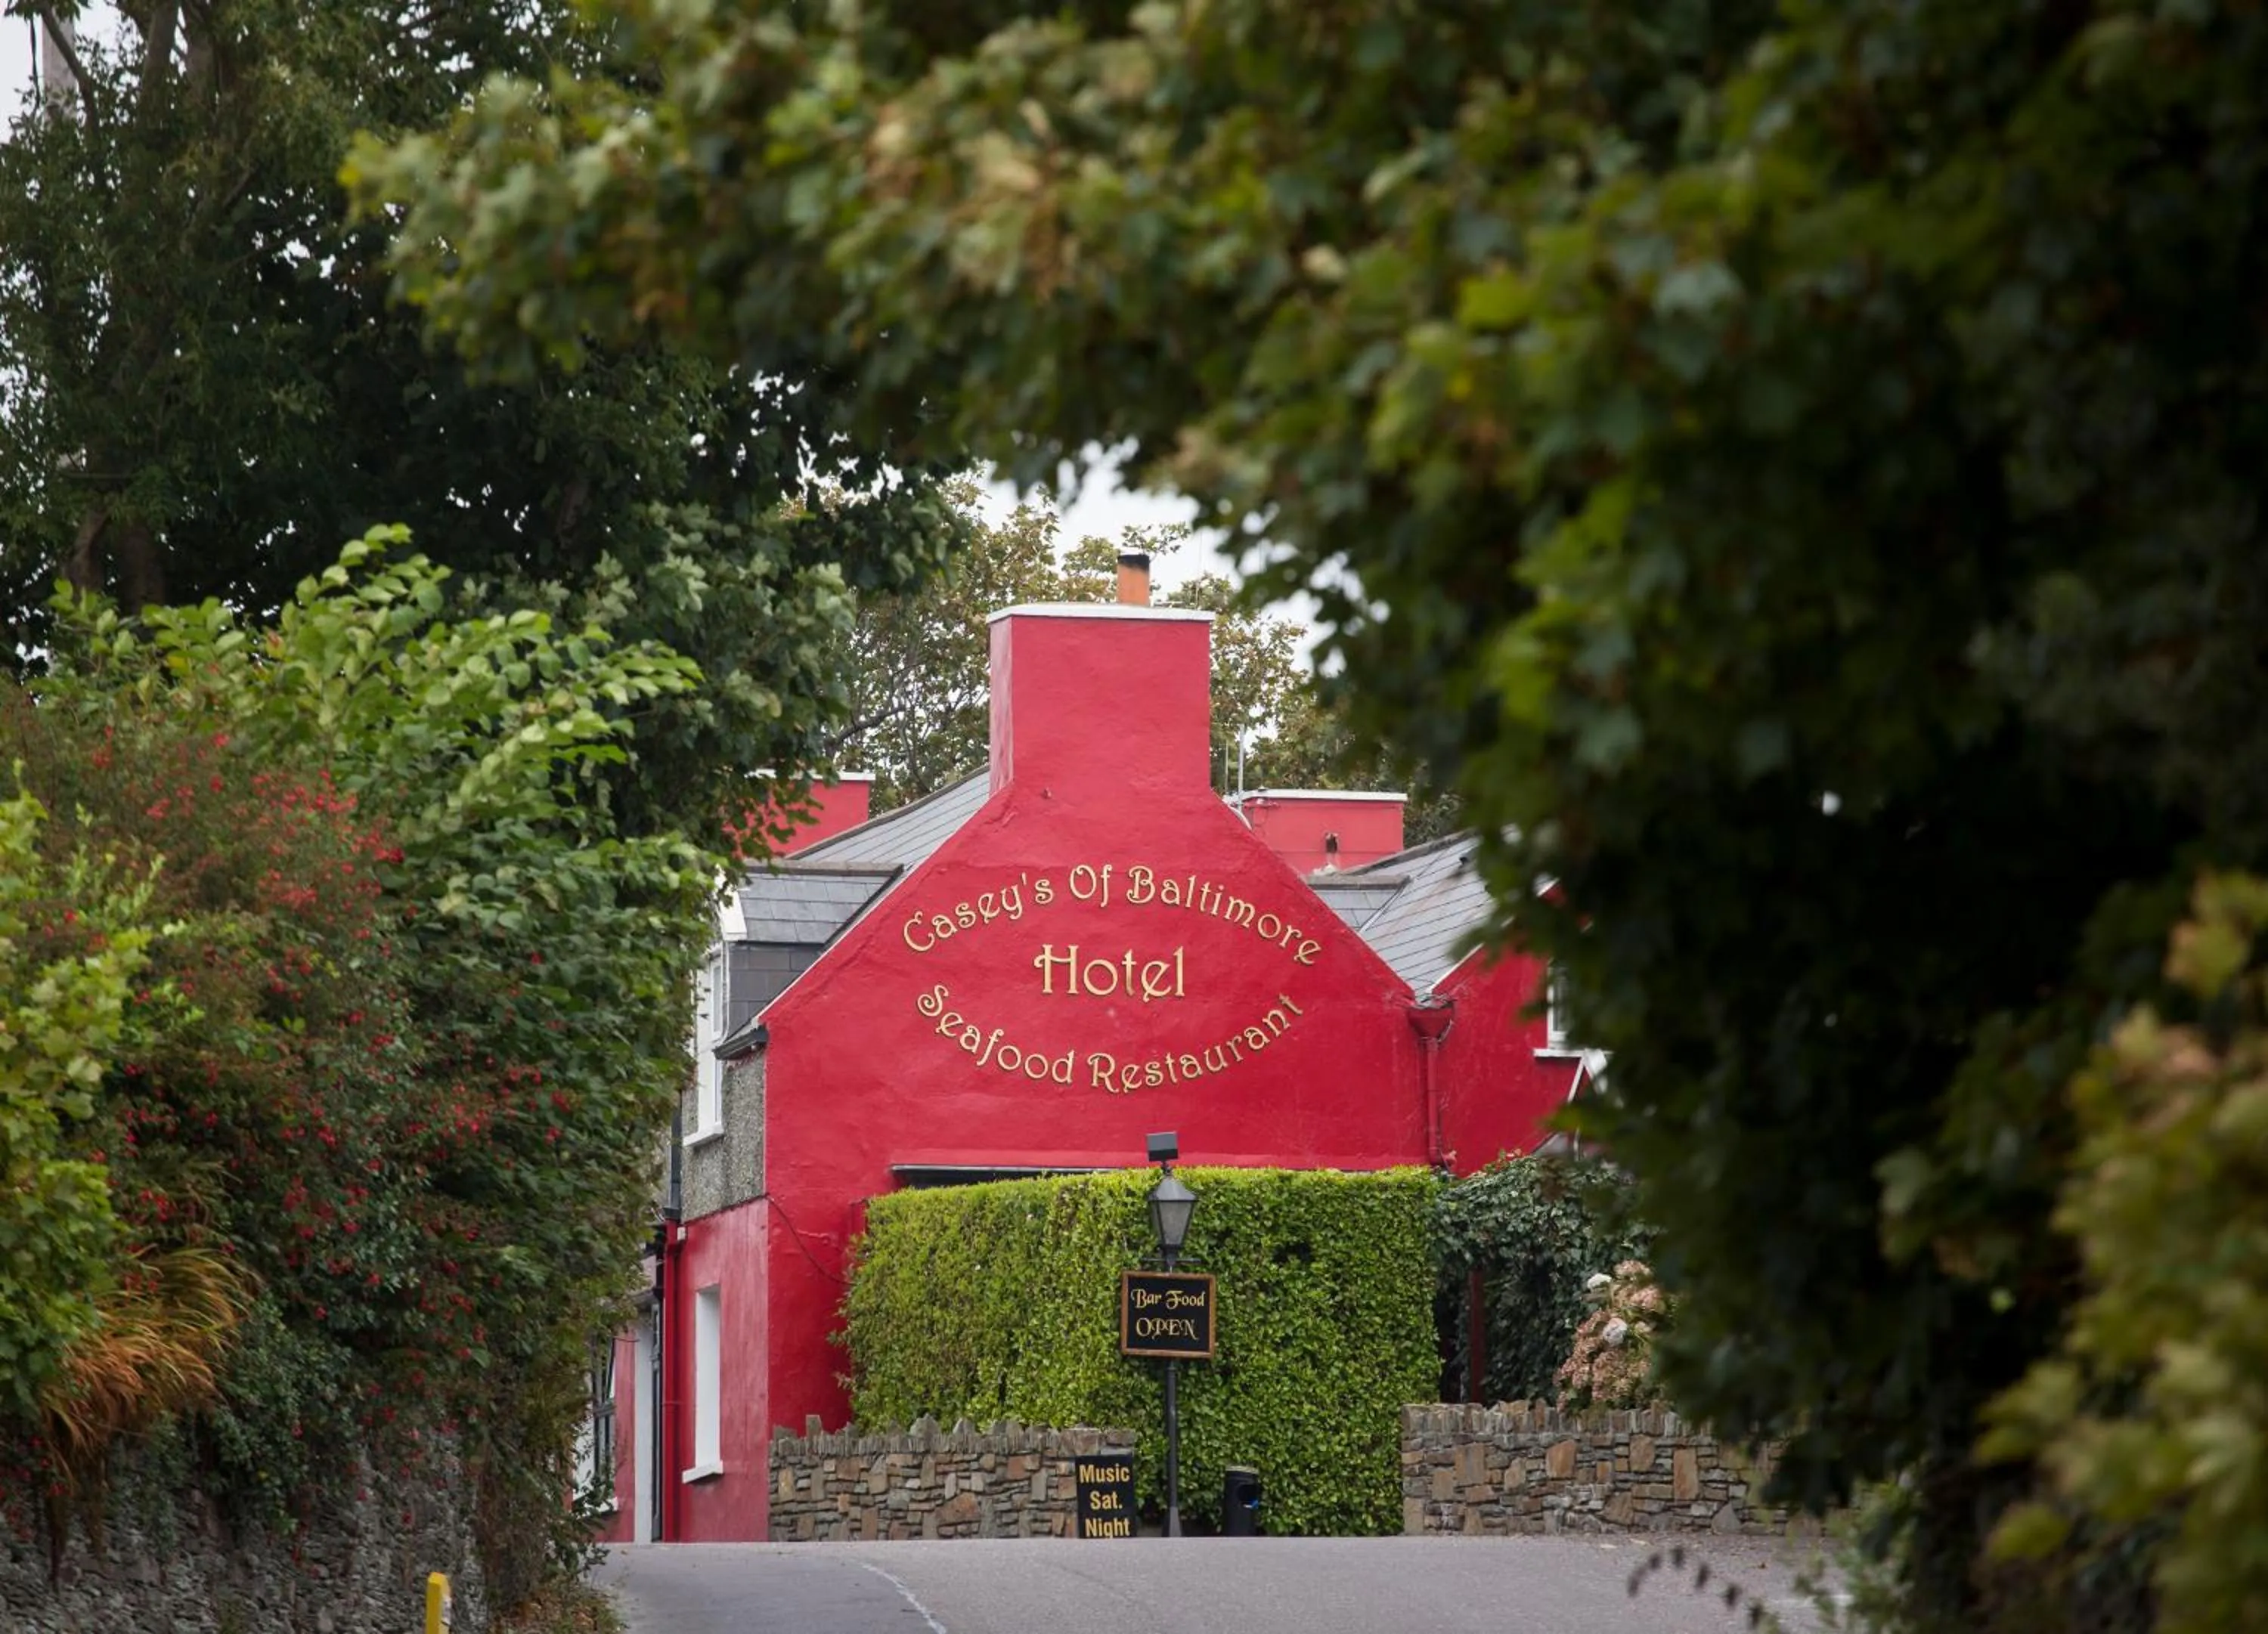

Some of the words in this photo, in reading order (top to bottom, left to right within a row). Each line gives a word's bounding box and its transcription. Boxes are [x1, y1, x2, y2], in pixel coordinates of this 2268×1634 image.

[903, 872, 1054, 953] Casey's
[1069, 863, 1113, 907] Of
[1126, 865, 1322, 965] Baltimore
[1033, 944, 1185, 1003] Hotel
[916, 984, 1075, 1085] Seafood
[1087, 992, 1304, 1094] Restaurant
[1130, 1289, 1162, 1308] Bar
[1165, 1290, 1206, 1310] Food
[1136, 1317, 1199, 1341] OPEN
[1079, 1463, 1130, 1484] Music
[1089, 1490, 1123, 1510] Sat.
[1085, 1518, 1130, 1538] Night
